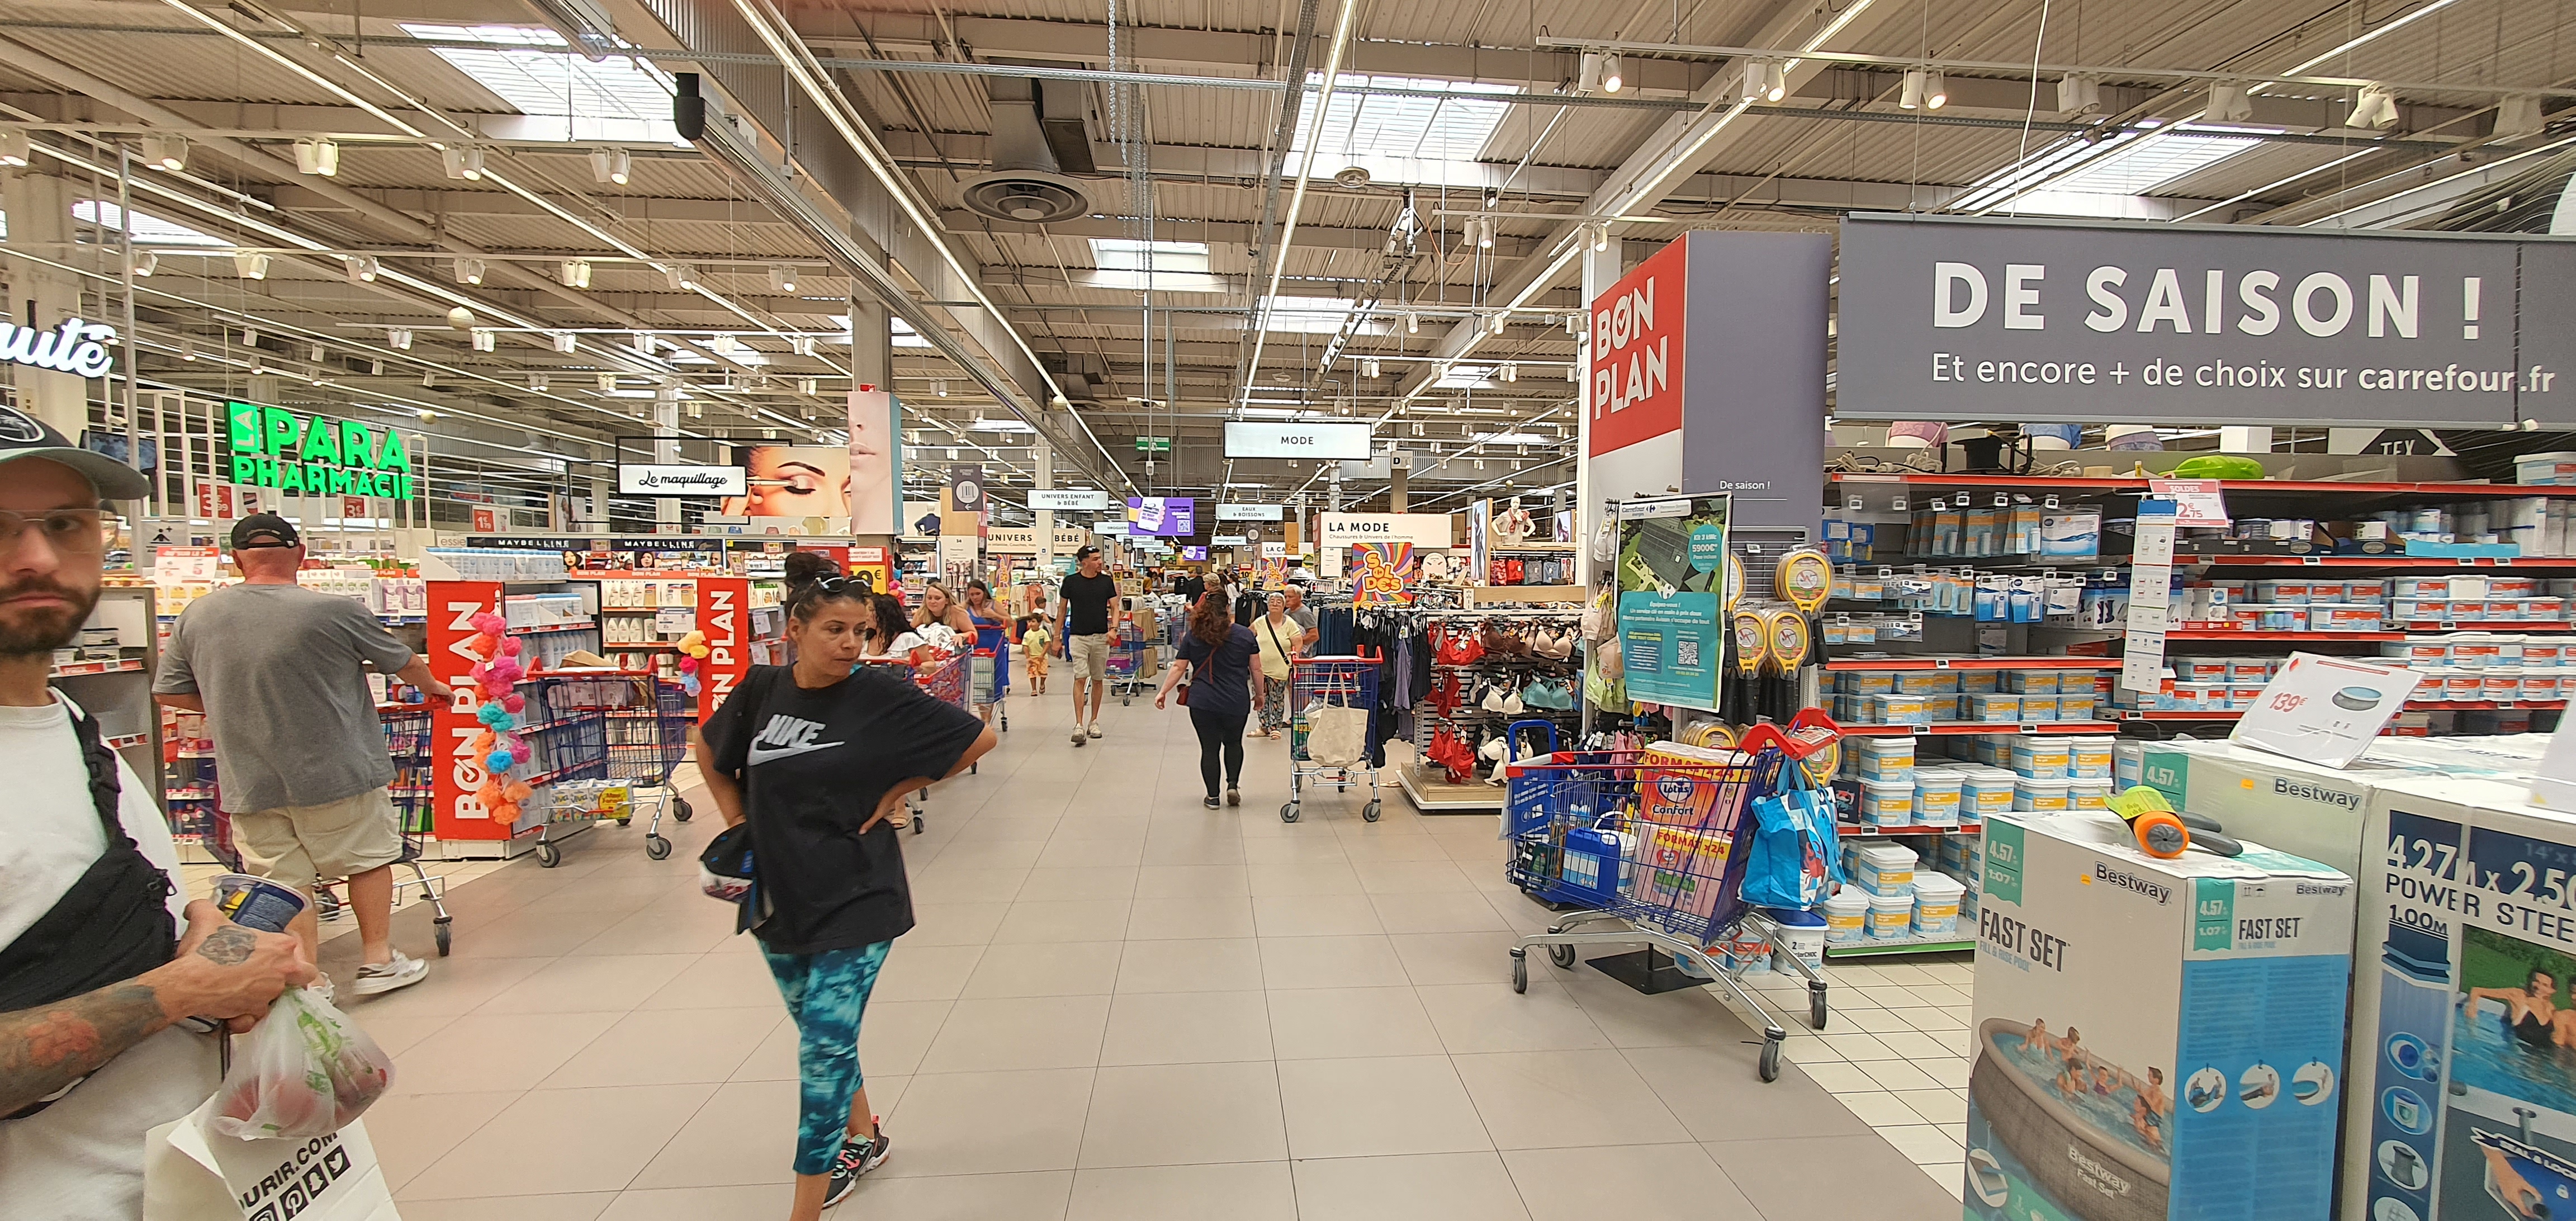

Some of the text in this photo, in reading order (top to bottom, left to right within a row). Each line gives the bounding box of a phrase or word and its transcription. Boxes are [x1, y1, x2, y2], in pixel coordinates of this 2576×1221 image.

[1934, 262, 2480, 340] DE SAISON !
[1595, 276, 1655, 362] BON
[1594, 335, 1668, 420] PLAN
[1933, 353, 2554, 393] Et encore + de choix sur carrefour.fr
[235, 410, 255, 446] LA
[266, 407, 410, 473] PARA
[1281, 436, 1314, 444] MODE
[1393, 457, 1400, 465] D
[234, 456, 415, 500] PHARMACIE
[638, 470, 728, 489] Le maquillage
[1720, 481, 1770, 490] De saison !
[1054, 533, 1079, 542] BÉBÉ
[1329, 522, 1389, 532] LA MODE
[441, 537, 466, 546] essie
[498, 539, 569, 548] MAYBELLINE
[624, 541, 694, 549] MAYBELLINE
[711, 590, 734, 665] PLAN
[711, 673, 734, 713] ON
[2269, 692, 2308, 713] 139€
[759, 714, 827, 745] NIKE
[2147, 766, 2175, 786] 4.57
[2274, 778, 2361, 811] Bestway
[1652, 804, 1694, 816] Confort
[1658, 831, 1725, 855] FORMAT x24
[1989, 840, 2013, 862] 4.57
[2096, 862, 2171, 905] Bestway
[2296, 884, 2346, 897] Bestway
[2200, 900, 2223, 915] 4.57
[2385, 873, 2575, 944] POWER STEE
[1980, 907, 2067, 972] FAST SET
[2238, 917, 2300, 940] FAST SET
[1792, 941, 1797, 950] 2
[1980, 940, 1991, 955] FILL
[1998, 949, 2012, 964] RISE
[2014, 955, 2030, 973] POOL
[2069, 1146, 2129, 1195] Bestway
[2077, 1168, 2114, 1199] Fast Set
